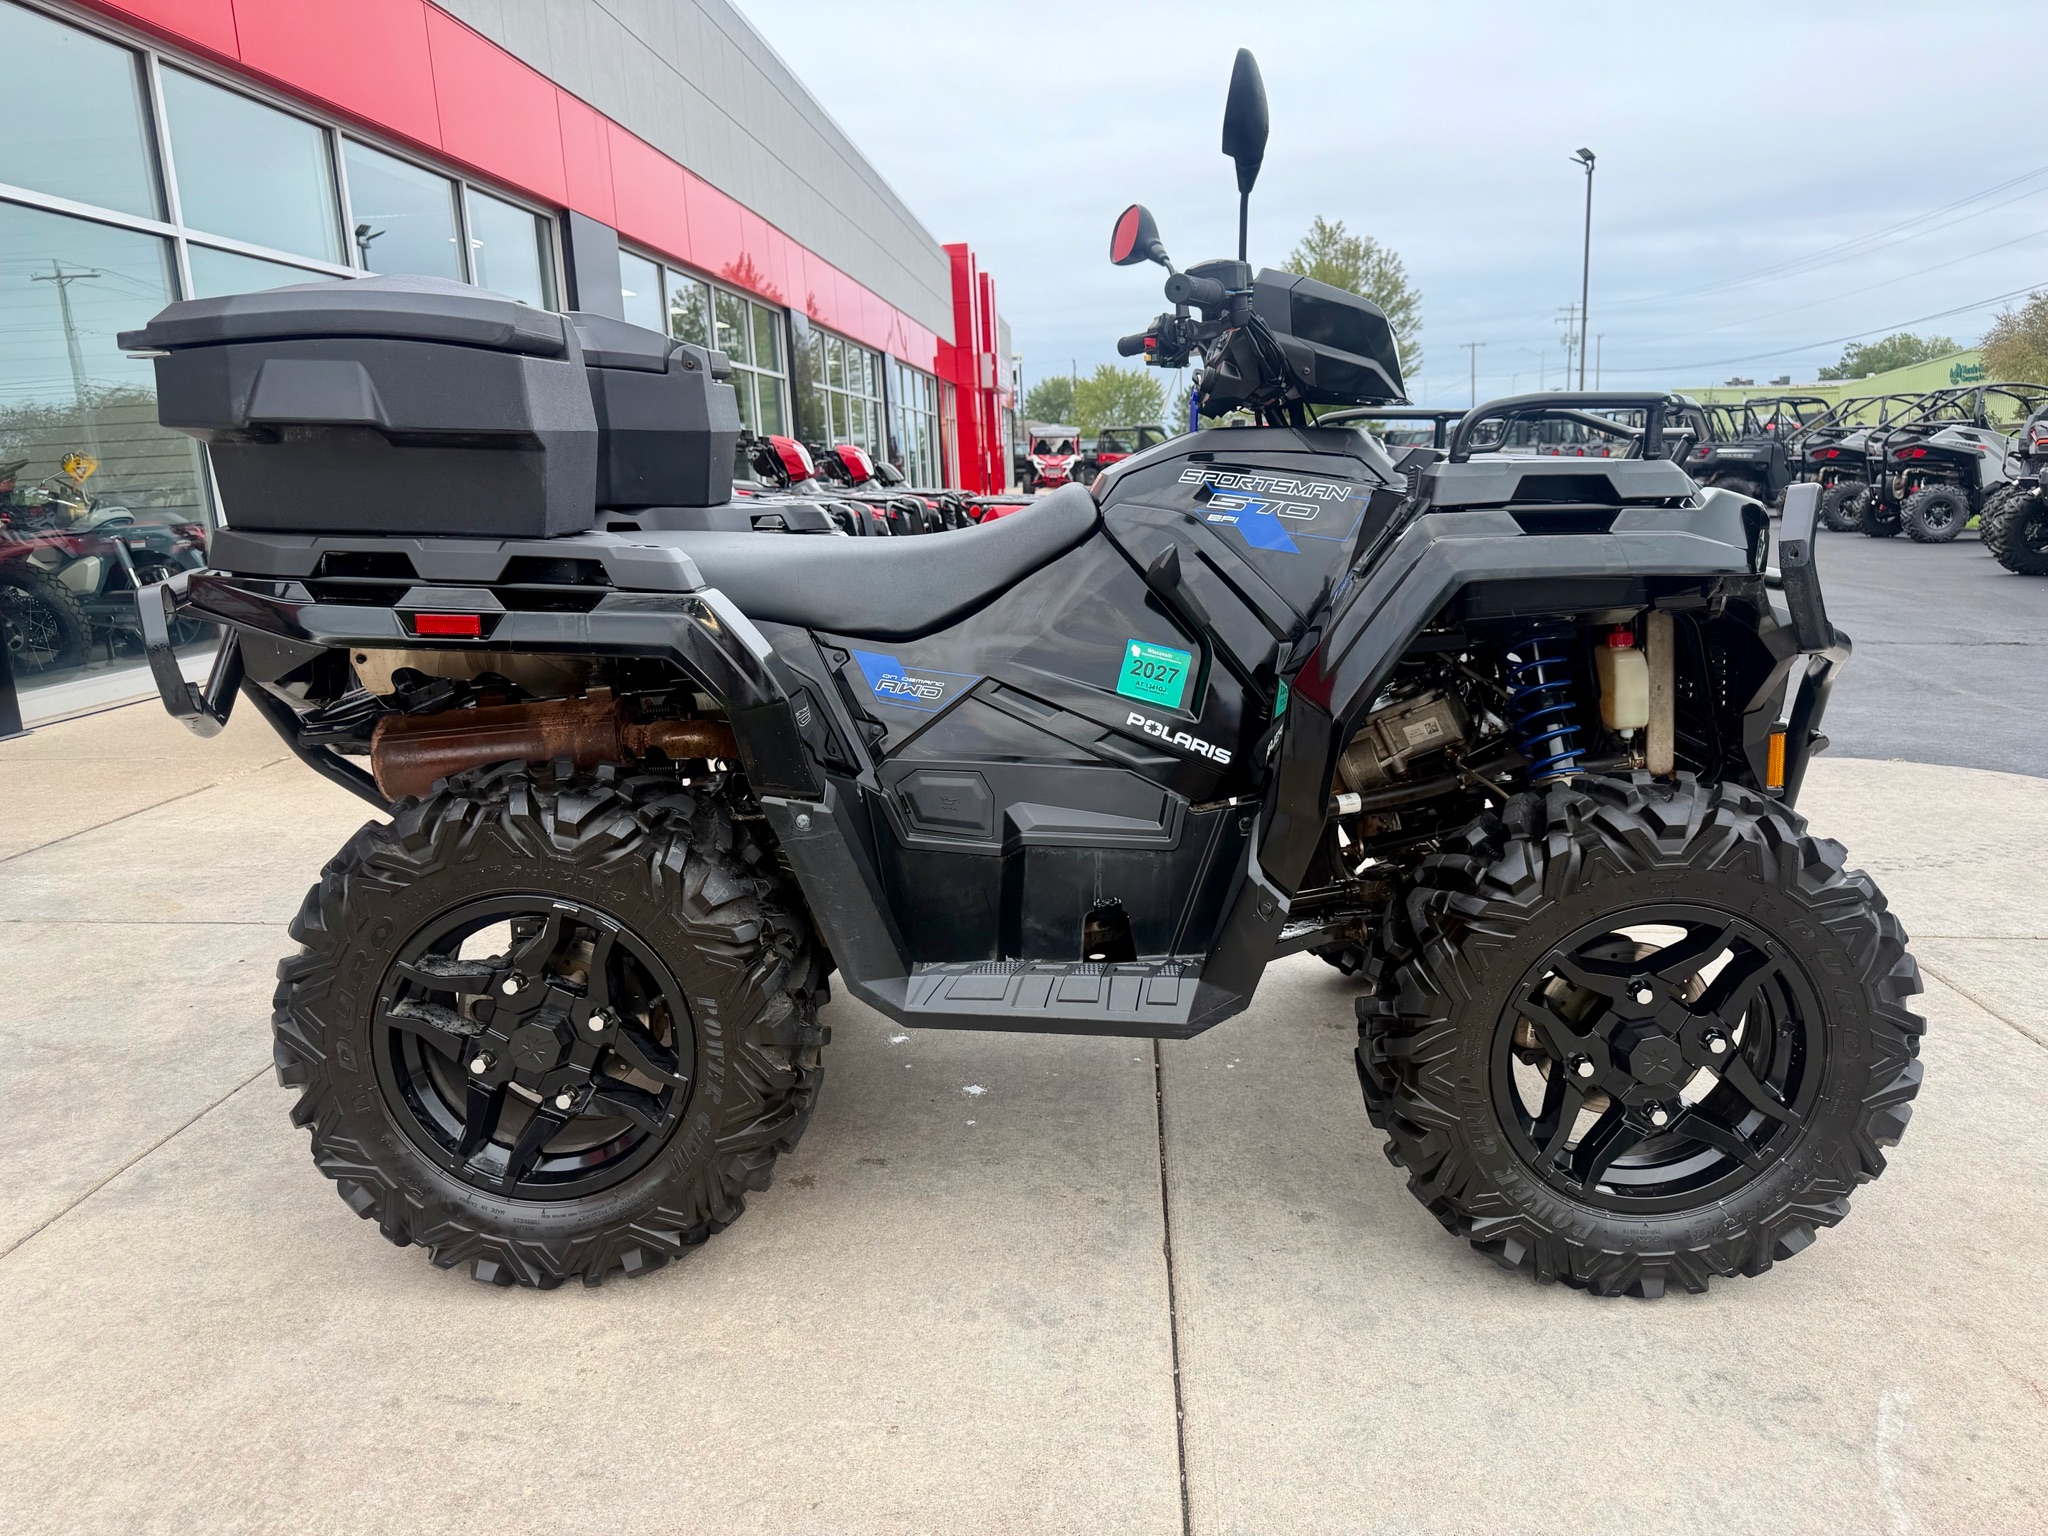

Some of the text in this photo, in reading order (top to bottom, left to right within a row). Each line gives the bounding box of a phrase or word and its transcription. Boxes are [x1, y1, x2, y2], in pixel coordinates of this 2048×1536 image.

[1178, 468, 1352, 502] SPORTSMAN
[1206, 494, 1321, 521] 570
[1206, 514, 1239, 524] EFI
[1147, 648, 1173, 658] Wisconsin
[901, 676, 945, 687] DEMAND
[1130, 659, 1180, 684] 2027
[875, 679, 943, 700] AWD
[1125, 711, 1232, 766] POLARIS
[335, 915, 396, 1074] DURO
[670, 996, 726, 1183] POWER GRIP
[1493, 1165, 1599, 1241] POWER
